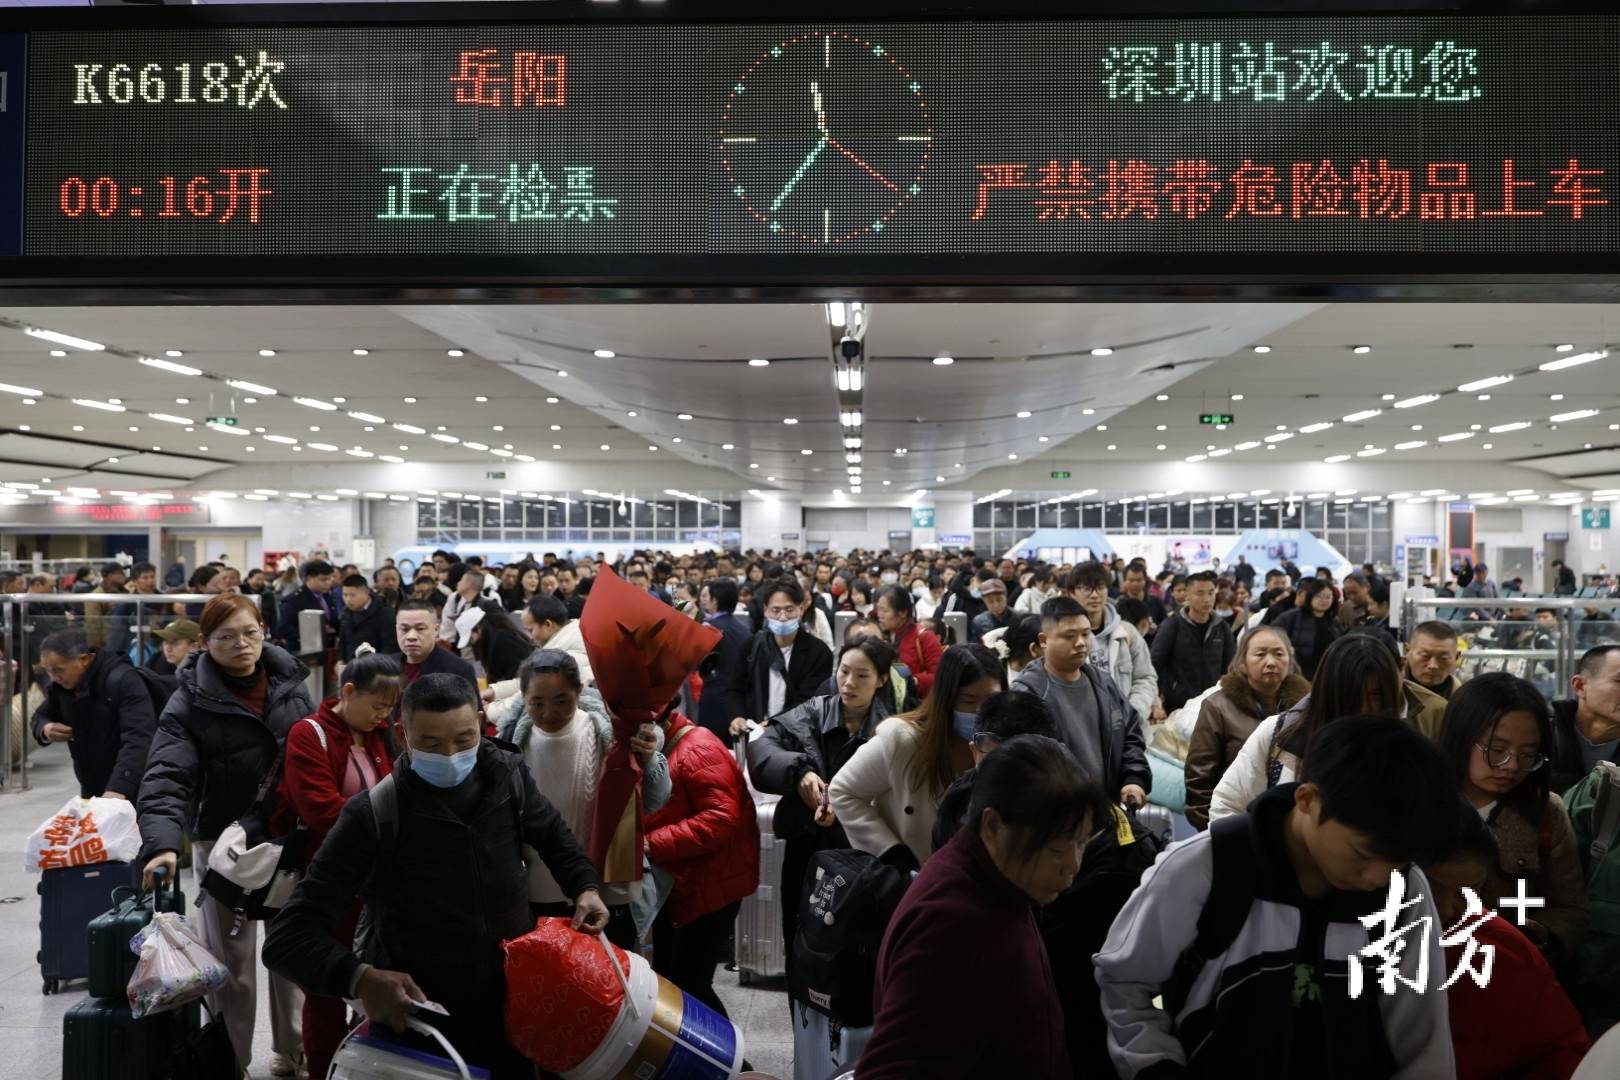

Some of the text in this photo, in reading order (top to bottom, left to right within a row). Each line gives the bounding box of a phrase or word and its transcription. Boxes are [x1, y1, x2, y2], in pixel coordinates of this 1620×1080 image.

[73, 51, 288, 109] K6618次
[449, 49, 566, 107] 岳阳
[1101, 41, 1482, 102] 深圳站欢迎您
[60, 168, 272, 223] 00:16开
[377, 163, 618, 222] 正在检票
[971, 159, 1609, 221] 严禁携带危险物品上车
